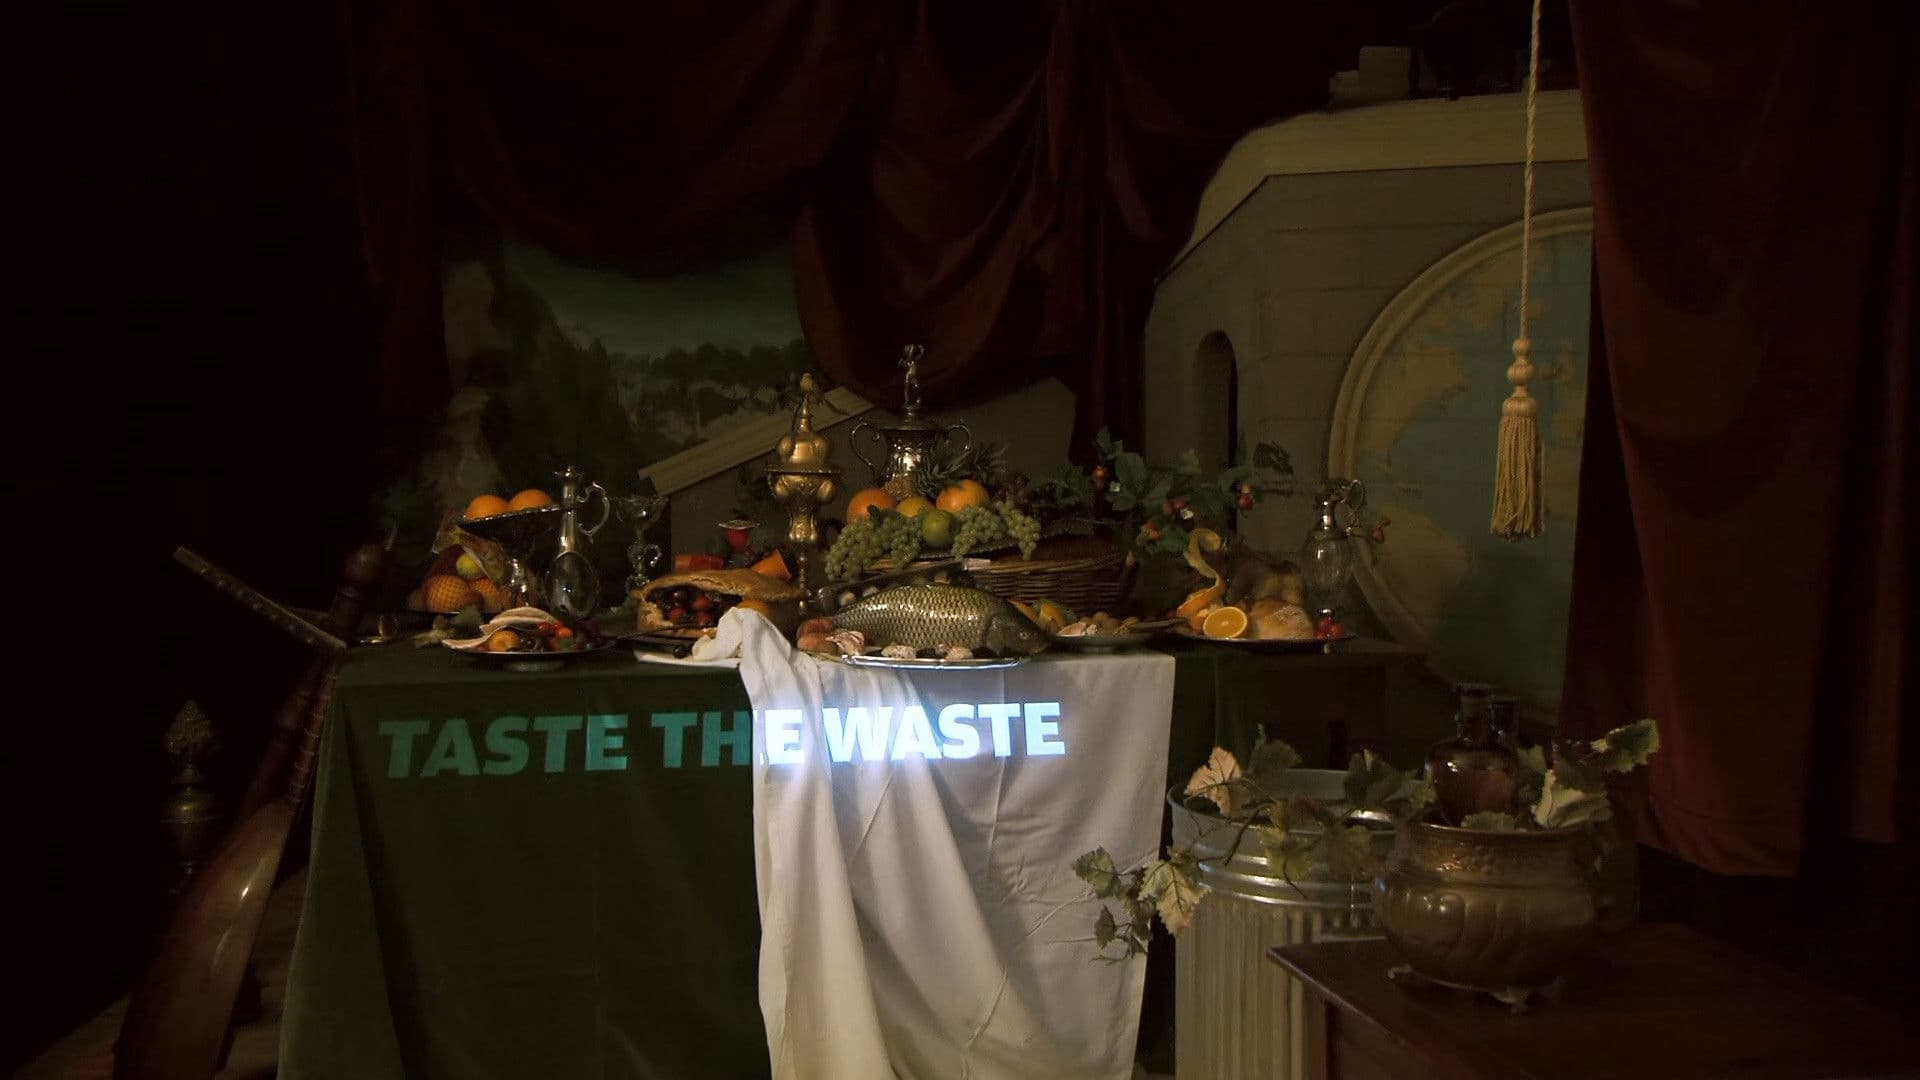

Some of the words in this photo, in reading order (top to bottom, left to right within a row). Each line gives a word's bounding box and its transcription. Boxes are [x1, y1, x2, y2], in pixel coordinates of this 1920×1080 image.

[378, 714, 629, 778] TASTE
[651, 709, 804, 768] THE
[822, 702, 1066, 762] WASTE
